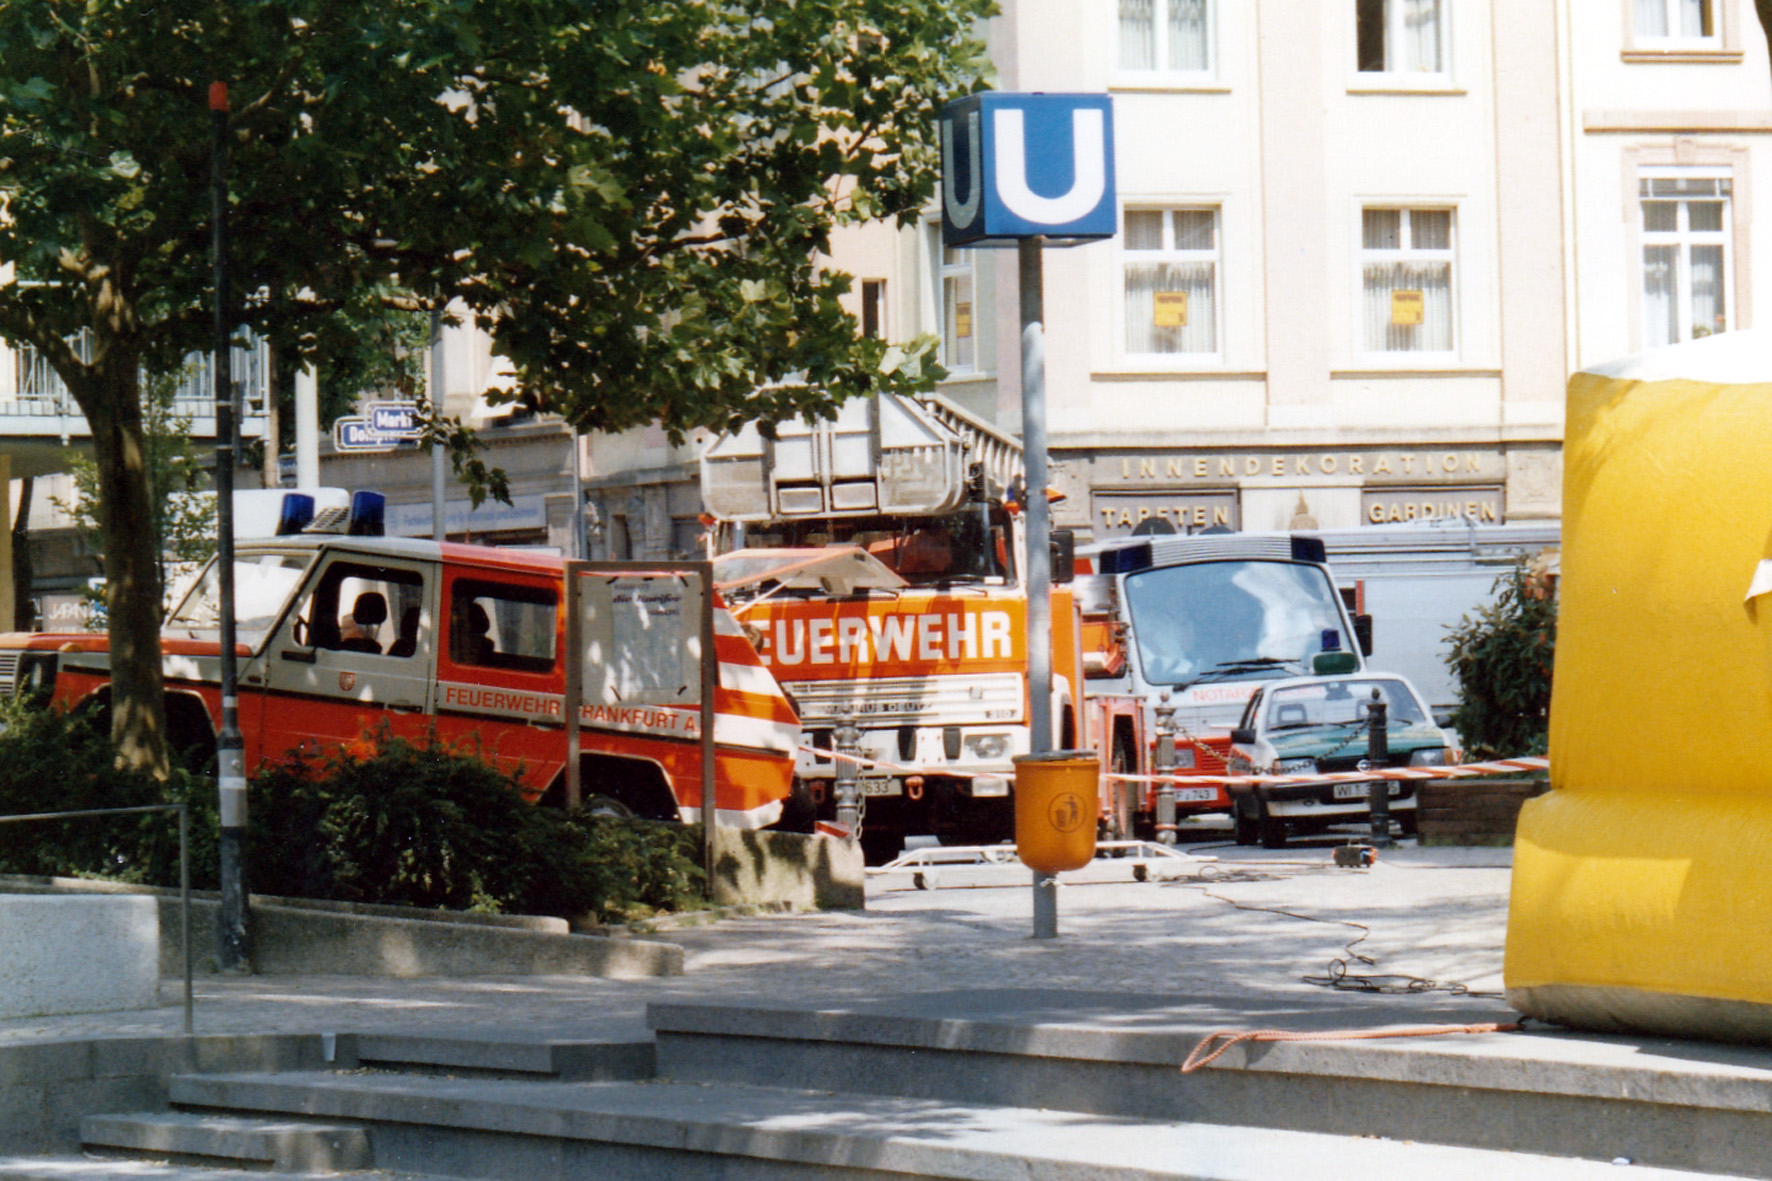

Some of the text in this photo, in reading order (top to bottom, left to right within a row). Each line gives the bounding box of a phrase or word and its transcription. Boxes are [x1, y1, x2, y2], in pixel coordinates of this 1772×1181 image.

[943, 111, 980, 229] U
[994, 108, 1105, 225] U
[1122, 453, 1482, 479] INNENDEKORATION
[1101, 505, 1229, 528] TAPETEN
[1368, 501, 1496, 523] GARDINEN
[746, 610, 1012, 667] EUERWEHR
[446, 687, 562, 716] FEUERWEHR
[579, 703, 679, 730] RANKFURT
[863, 780, 889, 794] 633
